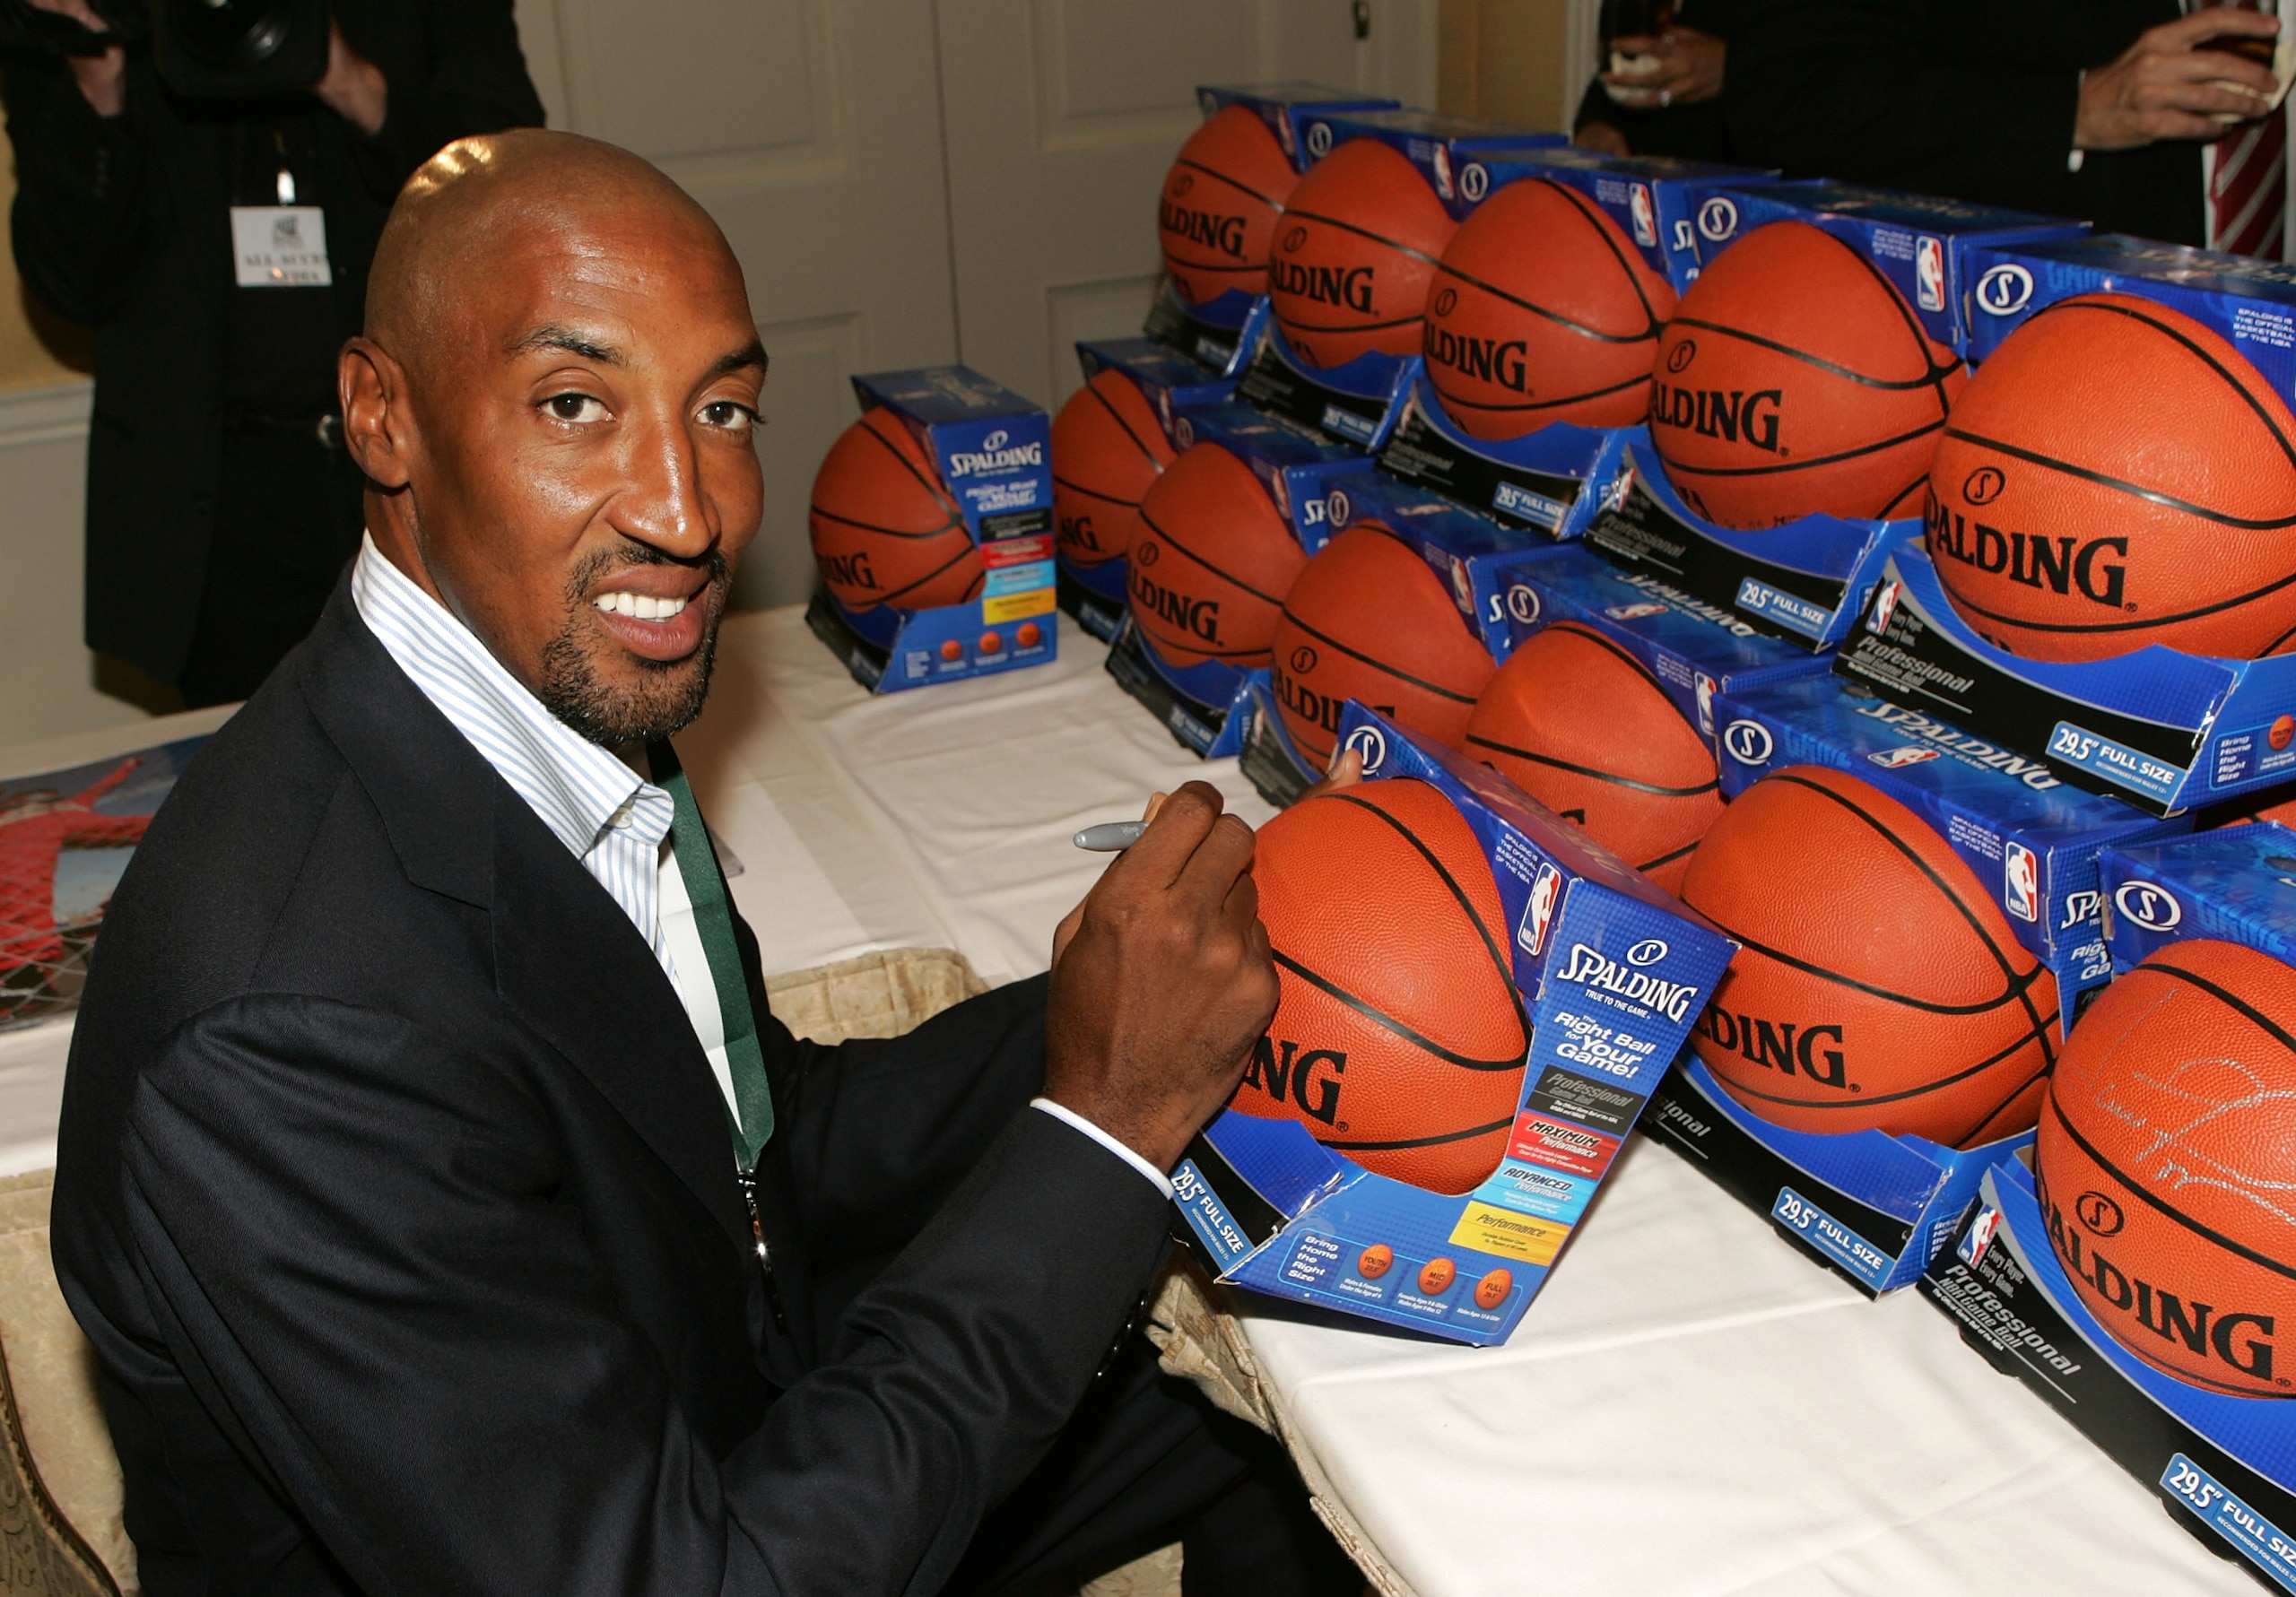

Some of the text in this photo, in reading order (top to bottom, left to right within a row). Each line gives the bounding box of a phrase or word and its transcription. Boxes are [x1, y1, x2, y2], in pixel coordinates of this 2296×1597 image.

[1162, 204, 1247, 258] LDING
[1273, 258, 1375, 313] LDING
[2233, 323, 2295, 341] BASKETBALL
[951, 442, 1041, 477] SPALDING
[1131, 568, 1220, 643] LDING
[1773, 595, 1799, 614] FULL
[1800, 607, 1826, 624] SIZE
[1857, 635, 1975, 693] Professional
[1857, 703, 2061, 790] SPALDING
[2220, 744, 2251, 756] Home
[2221, 736, 2249, 748] Bring
[2054, 728, 2176, 785] 29.5" FULL SIZE
[2218, 761, 2246, 774] Right
[2219, 756, 2237, 765] the
[2217, 772, 2239, 783] Size
[1949, 827, 2003, 856] BASKETBALL
[1496, 846, 1535, 879] BASKETBALL
[2010, 898, 2027, 915] NBA
[1521, 927, 1535, 946] NBA
[2070, 942, 2106, 960] Rig
[1557, 943, 1699, 1023] SPALDING
[2081, 961, 2111, 981] Ga
[1585, 989, 1648, 1019] TRUE TO THE GAME
[1582, 1014, 1596, 1023] The
[1553, 1011, 1657, 1055] Right Ball
[1565, 1031, 1643, 1066] for Your
[1556, 1043, 1639, 1079] Game!
[1242, 1036, 1347, 1126] NG
[1547, 1073, 1633, 1107] Professional
[1549, 1086, 1596, 1106] Game Ball
[1528, 1121, 1600, 1148] MAXIMUM
[1539, 1136, 1598, 1159] Performance
[1503, 1167, 1573, 1191] ADVANCED
[1514, 1181, 1573, 1202] Performance
[1171, 1167, 1244, 1254] 29.5" FULL SIZE
[1476, 1214, 1546, 1237] Performance
[1779, 1194, 1883, 1270] 29.5" FULL SIZE
[1300, 1245, 1337, 1259] Home
[1305, 1236, 1339, 1251] Bring
[1292, 1261, 1326, 1275] Right
[1297, 1253, 1317, 1263] the
[1364, 1255, 1388, 1267] YOUTH
[1987, 1245, 2005, 1268] Every
[1288, 1270, 1315, 1281] Size
[1428, 1272, 1446, 1281] MID
[1979, 1259, 1996, 1283] Every
[1485, 1282, 1502, 1292] FULL
[1939, 1277, 2024, 1349] NBA Game Ball
[1945, 1263, 2082, 1376] Professional
[2170, 1462, 2223, 1508] 29.5"
[2222, 1500, 2266, 1543] FULL
[2217, 1516, 2290, 1577] RECOMMENDED FOR MALES
